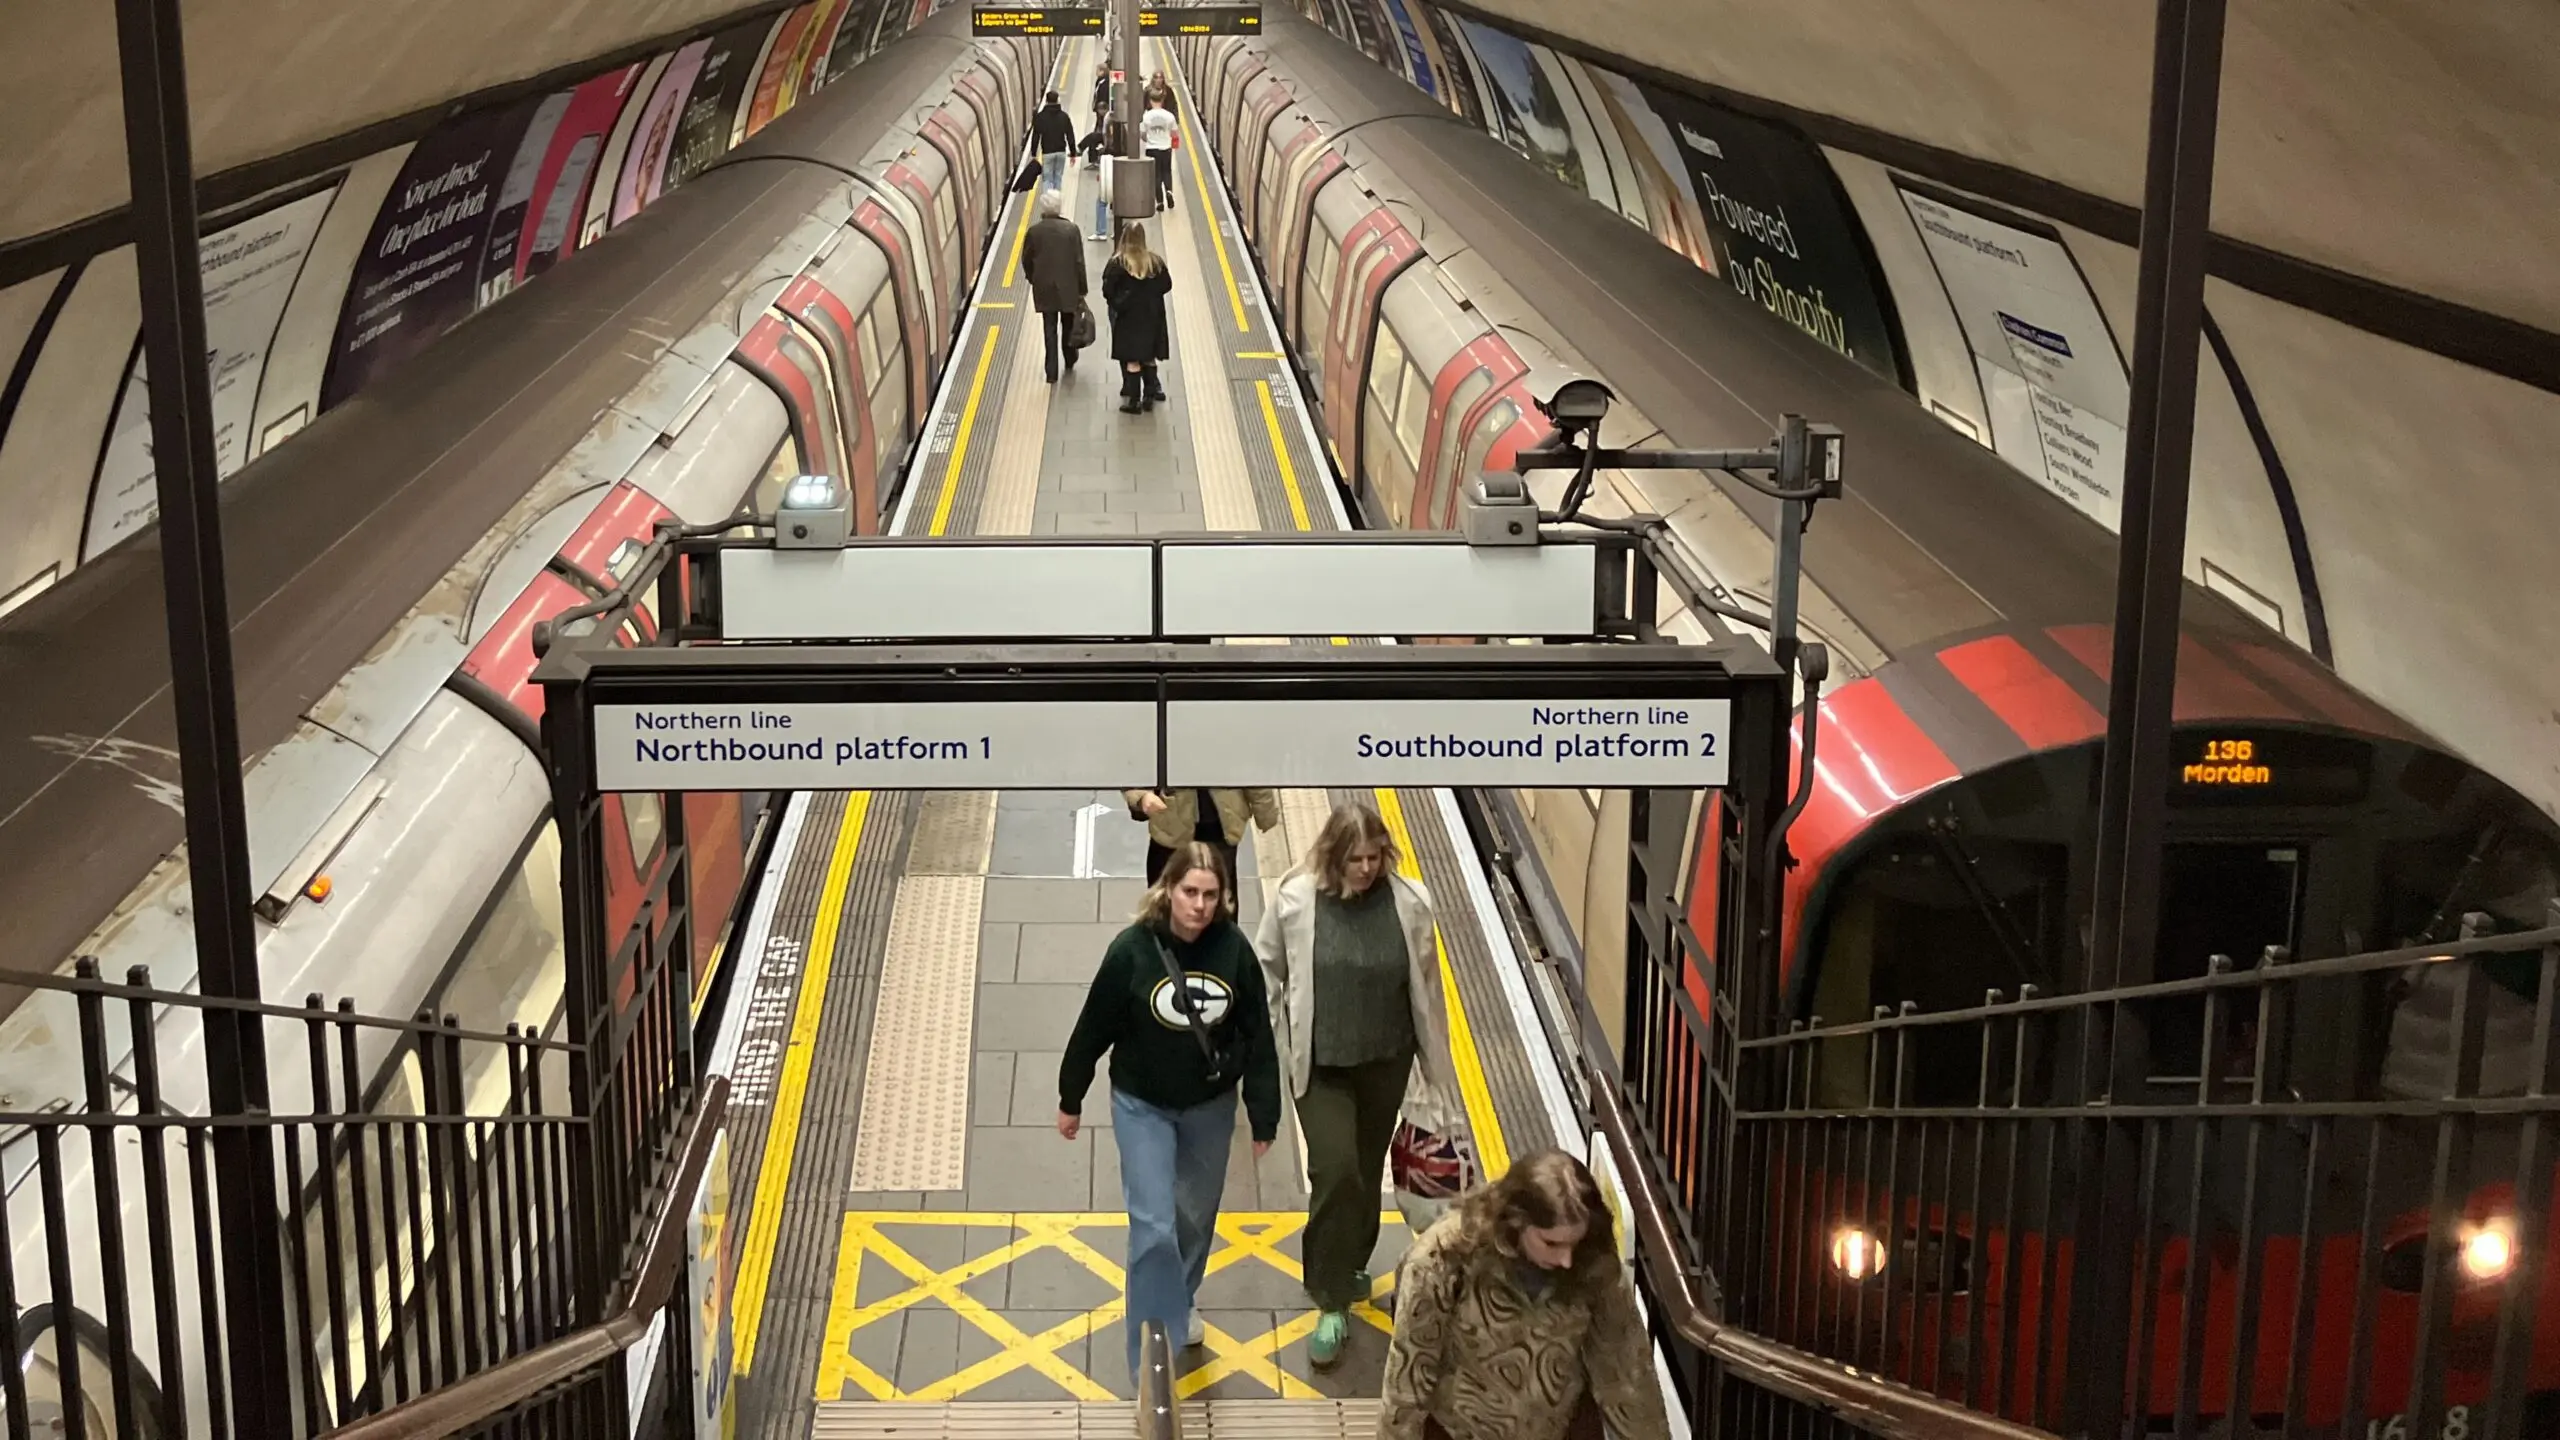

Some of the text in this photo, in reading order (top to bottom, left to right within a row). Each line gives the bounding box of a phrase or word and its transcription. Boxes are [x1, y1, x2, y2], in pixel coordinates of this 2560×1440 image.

[378, 221, 412, 259] One
[401, 206, 444, 256] place
[437, 194, 462, 231] for
[1701, 170, 1800, 261] Powered
[1724, 241, 1756, 301] by
[2014, 249, 2029, 268] 2
[636, 711, 793, 730] Northern line
[1532, 706, 1690, 726] Northern line
[636, 736, 990, 766] Northbound platform 1
[1357, 732, 1716, 763] Southbound platform 2
[2204, 740, 2253, 760] 136
[2183, 764, 2271, 783] Morden
[726, 934, 801, 1106] MIND THE GAP
